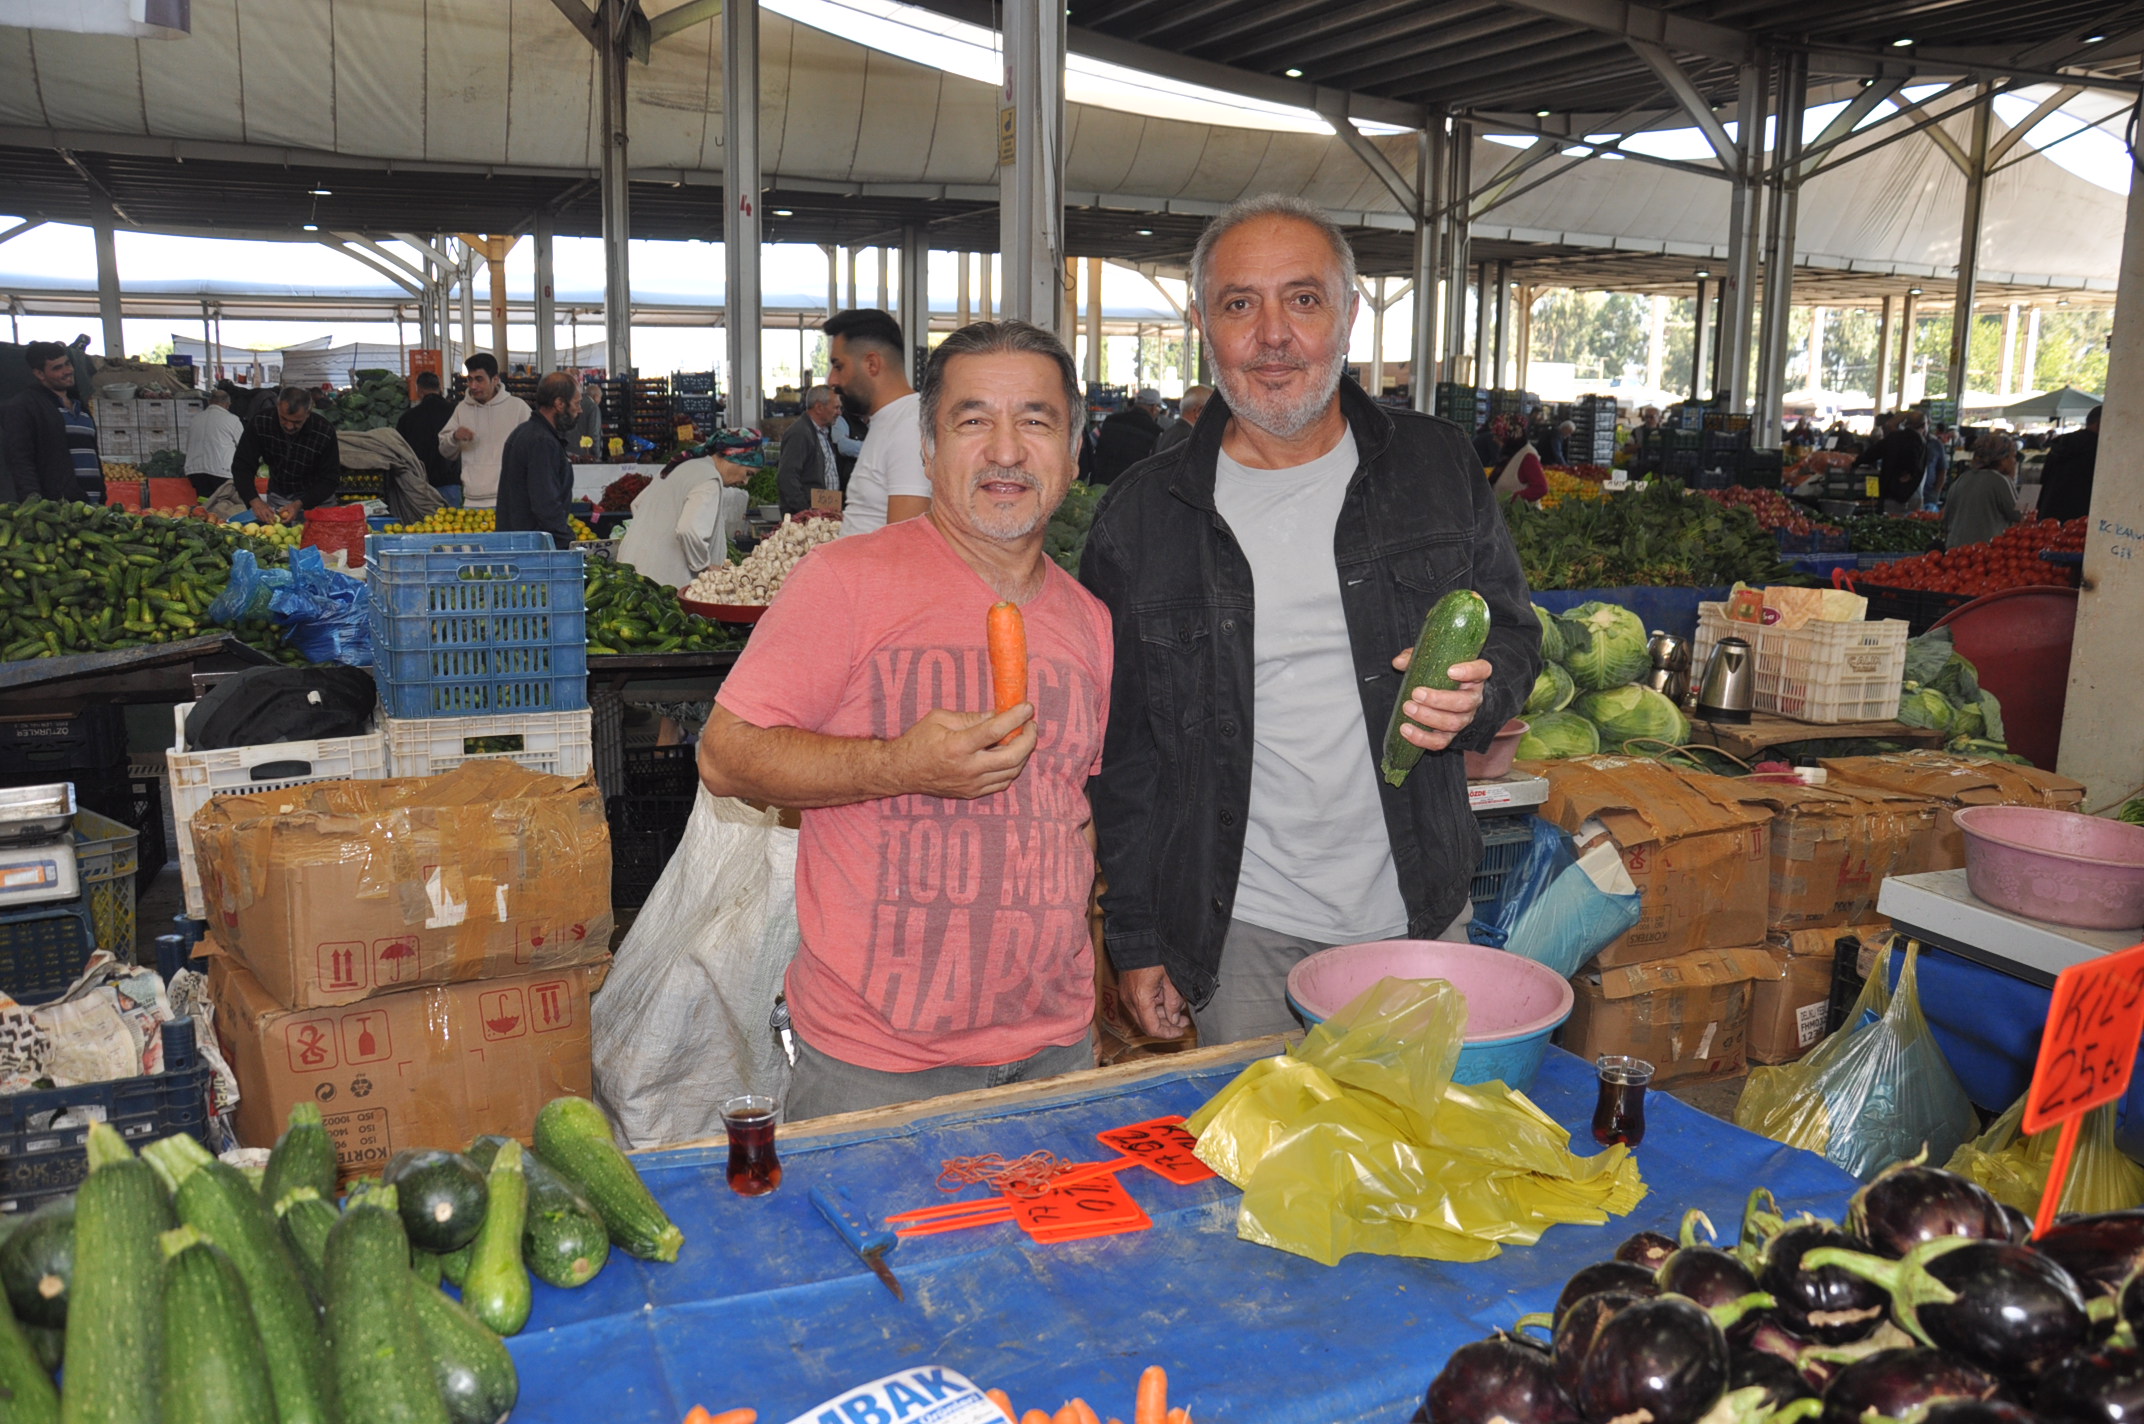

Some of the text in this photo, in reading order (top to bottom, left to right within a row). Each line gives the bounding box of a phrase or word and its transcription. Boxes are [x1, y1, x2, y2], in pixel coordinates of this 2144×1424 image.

[1005, 65, 1013, 102] 3
[740, 194, 752, 217] 4
[544, 285, 551, 298] 6
[495, 307, 502, 318] 7
[1027, 656, 1099, 757] CA
[880, 818, 1092, 906] TOO MUC
[864, 904, 1086, 1033] HAPP
[321, 1111, 374, 1127] ISO 10002
[358, 1124, 375, 1134] ISO
[335, 1136, 377, 1150] ISO 90
[338, 1146, 387, 1165] KORTE
